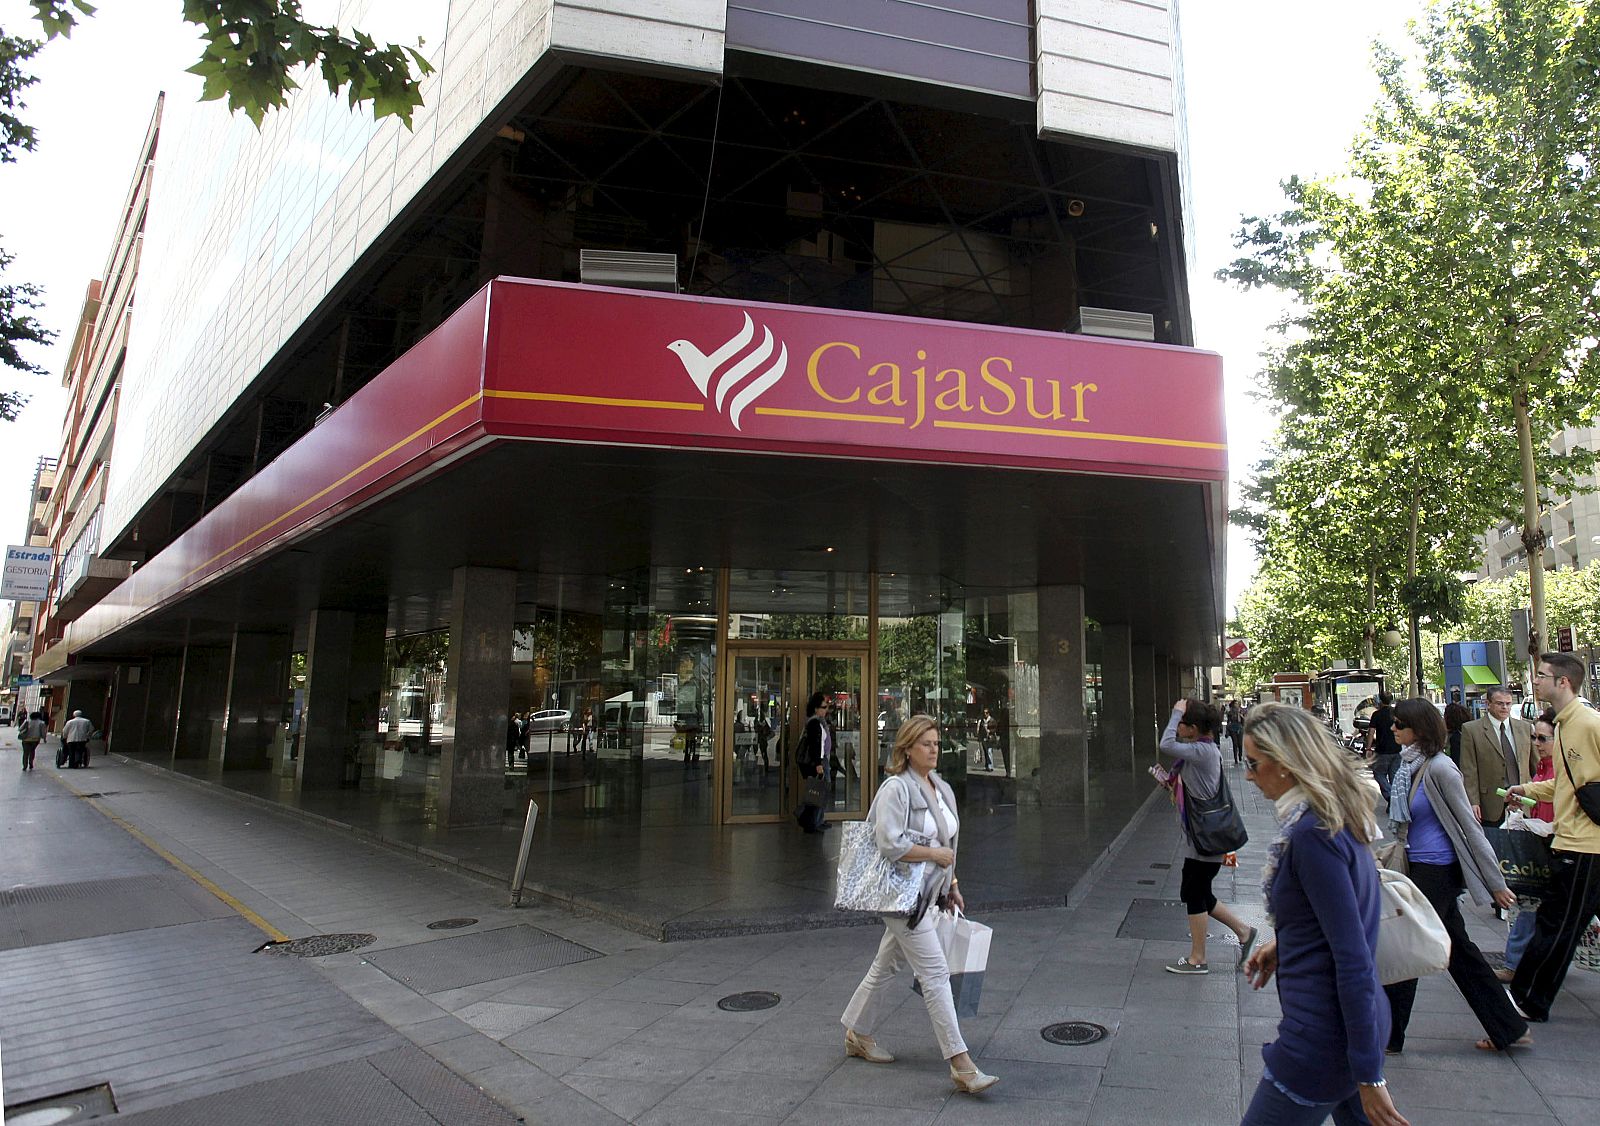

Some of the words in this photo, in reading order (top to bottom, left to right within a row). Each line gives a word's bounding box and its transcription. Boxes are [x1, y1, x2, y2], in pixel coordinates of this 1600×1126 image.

[807, 342, 1097, 429] CajaSur
[8, 549, 50, 561] Estrada
[6, 565, 48, 576] GESTORIA
